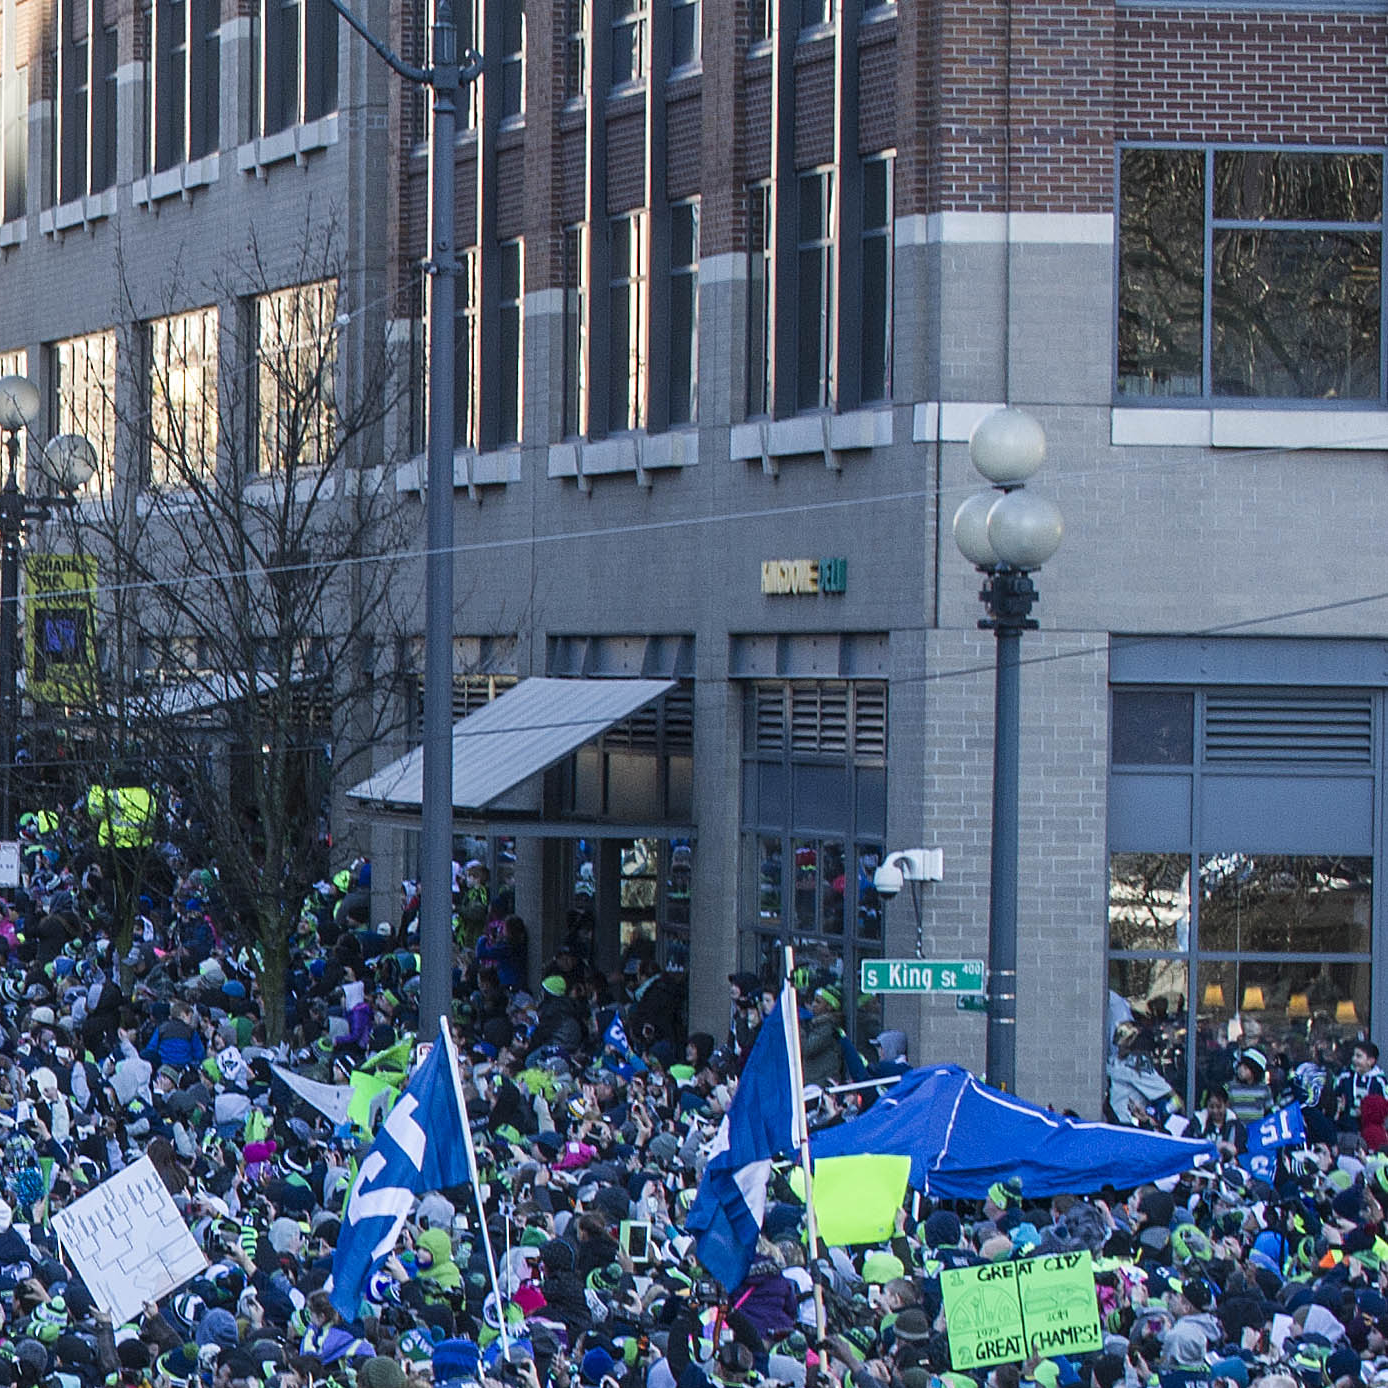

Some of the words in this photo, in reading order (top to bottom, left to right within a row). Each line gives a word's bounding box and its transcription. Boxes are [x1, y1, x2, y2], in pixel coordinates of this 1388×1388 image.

[888, 964, 933, 991] King
[941, 970, 958, 988] St
[962, 963, 981, 975] 400
[977, 1260, 1036, 1281] GREAT
[1043, 1252, 1083, 1271] CITY
[976, 1335, 1022, 1360] GREAT
[1031, 1324, 1099, 1350] CHAMPS!
